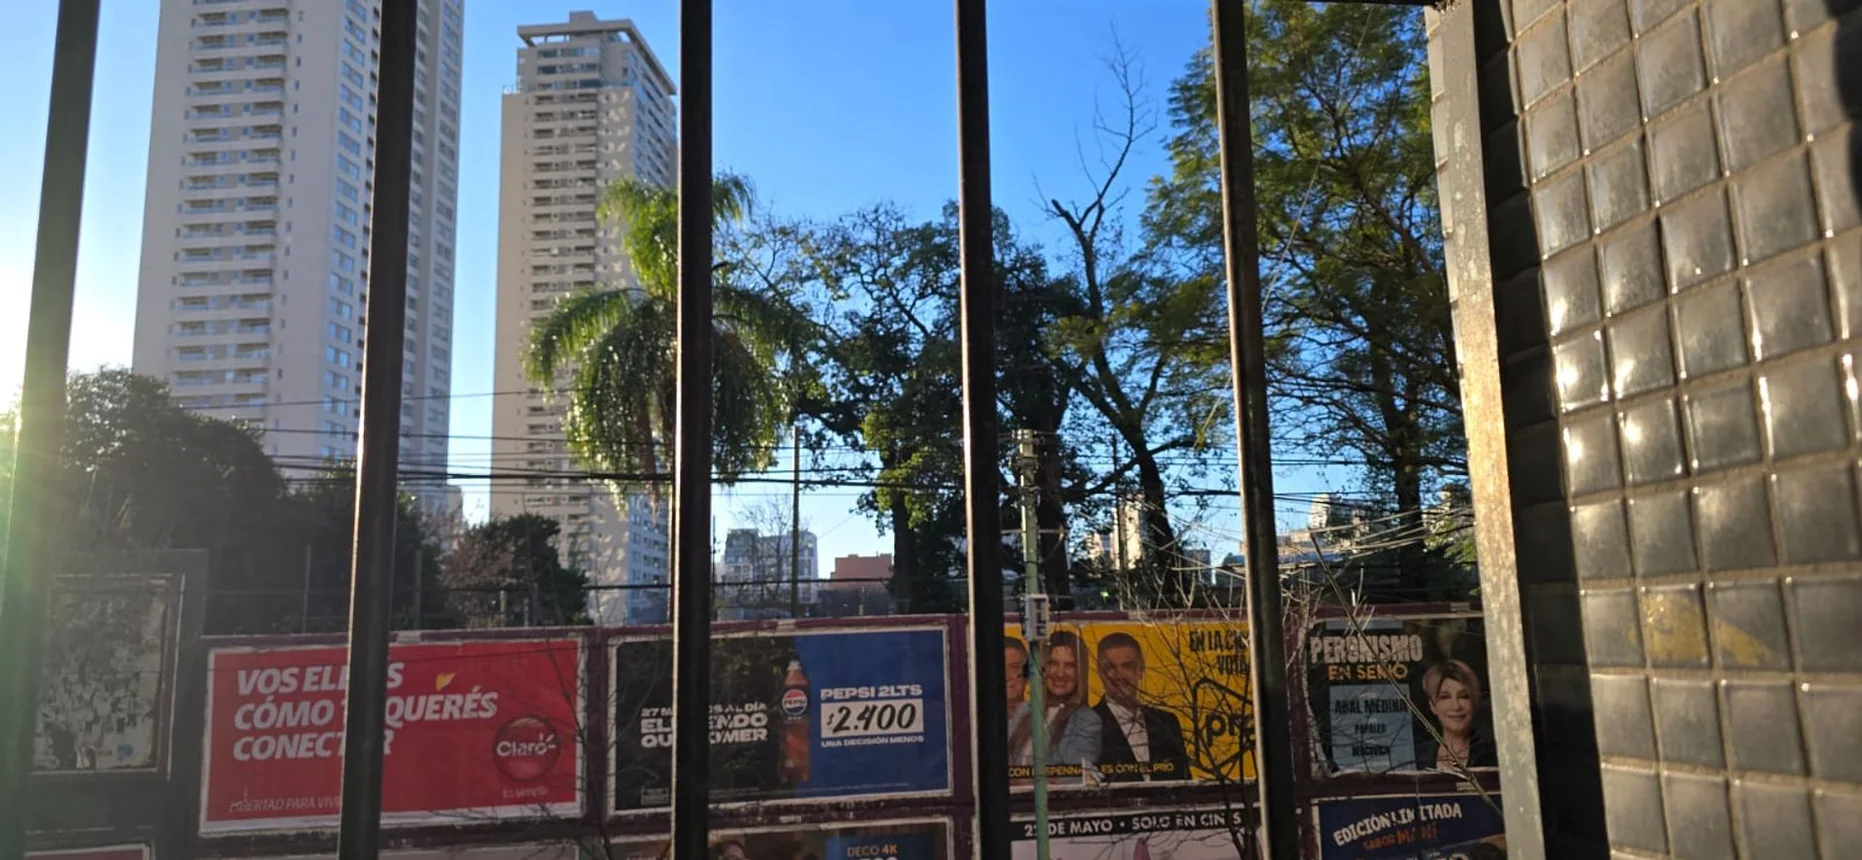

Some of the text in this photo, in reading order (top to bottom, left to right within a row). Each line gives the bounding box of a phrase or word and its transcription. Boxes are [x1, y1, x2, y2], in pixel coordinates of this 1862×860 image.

[1310, 634, 1423, 664] PERONISMO
[237, 661, 404, 695] VOS ELS
[1328, 664, 1351, 681] EN
[820, 684, 923, 701] PEPSI 2LTS
[234, 696, 334, 731] CÓMO
[385, 685, 499, 728] QUERÉS
[641, 708, 659, 719] 27
[743, 700, 766, 713] DÍA
[826, 703, 916, 734] $2.400
[233, 729, 395, 761] CONECTR
[496, 738, 550, 757] Claro
[641, 733, 673, 749] QU
[821, 734, 924, 748] UNA DECISIÓN MENOS
[1008, 766, 1030, 778] CON
[285, 795, 316, 810] PARA
[1048, 821, 1066, 836] DE
[1069, 818, 1113, 835] MAYO
[1176, 814, 1196, 829] EN
[1199, 812, 1242, 827] CINS
[1333, 812, 1392, 847] EDICIÓN
[846, 844, 880, 858] DECO
